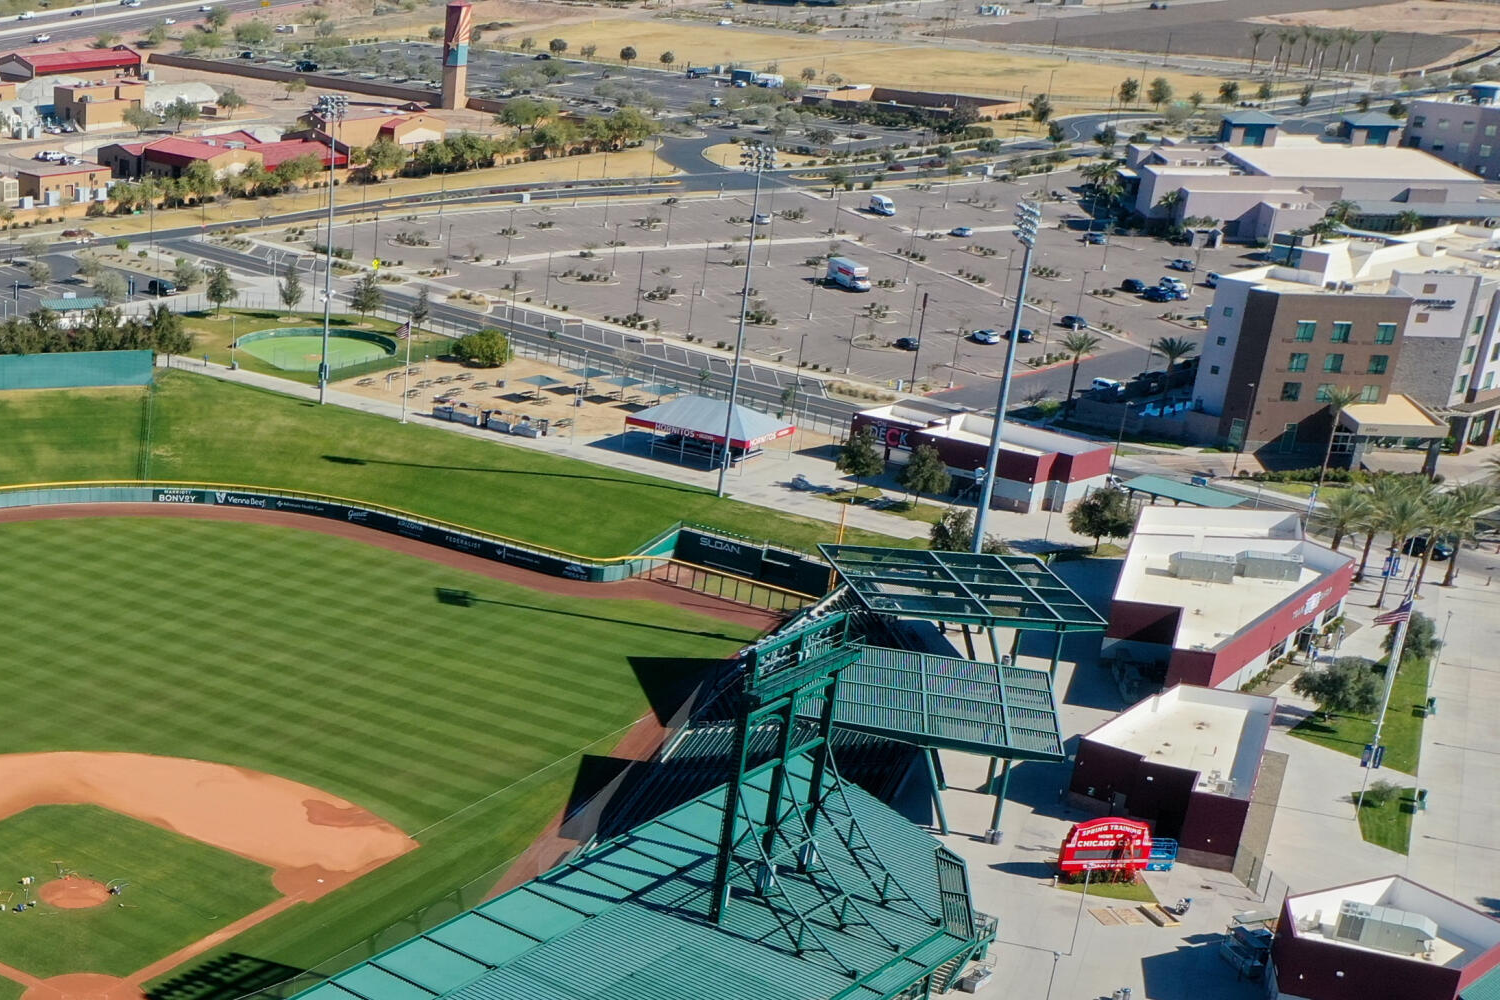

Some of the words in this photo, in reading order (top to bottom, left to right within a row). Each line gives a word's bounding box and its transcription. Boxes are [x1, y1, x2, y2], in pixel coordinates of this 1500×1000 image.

[654, 422, 696, 438] HORNITOS
[870, 426, 908, 446] DECK
[159, 494, 196, 503] BONVOY
[227, 495, 251, 505] Vienna
[250, 497, 266, 508] Beef
[700, 536, 741, 554] SLOAN
[1082, 826, 1108, 836] SPRING
[1110, 824, 1142, 835] TRAINING
